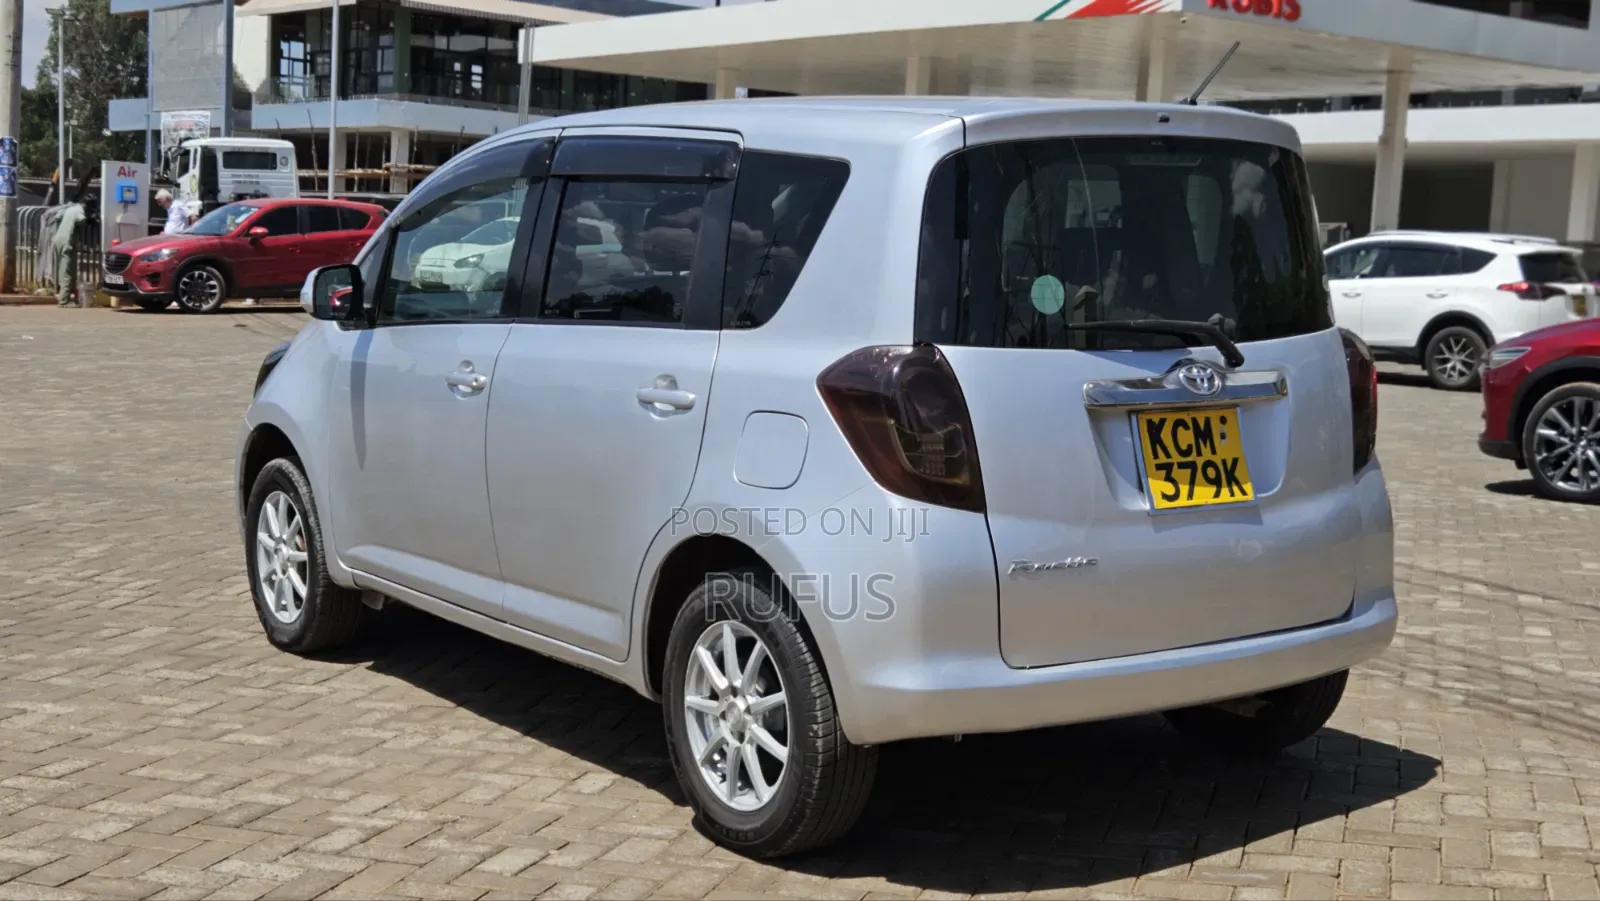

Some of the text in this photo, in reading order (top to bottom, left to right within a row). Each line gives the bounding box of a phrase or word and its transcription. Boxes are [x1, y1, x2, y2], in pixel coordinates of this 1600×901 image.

[117, 166, 138, 178] Air
[1146, 416, 1217, 460] KCM
[1155, 457, 1248, 502] 379K
